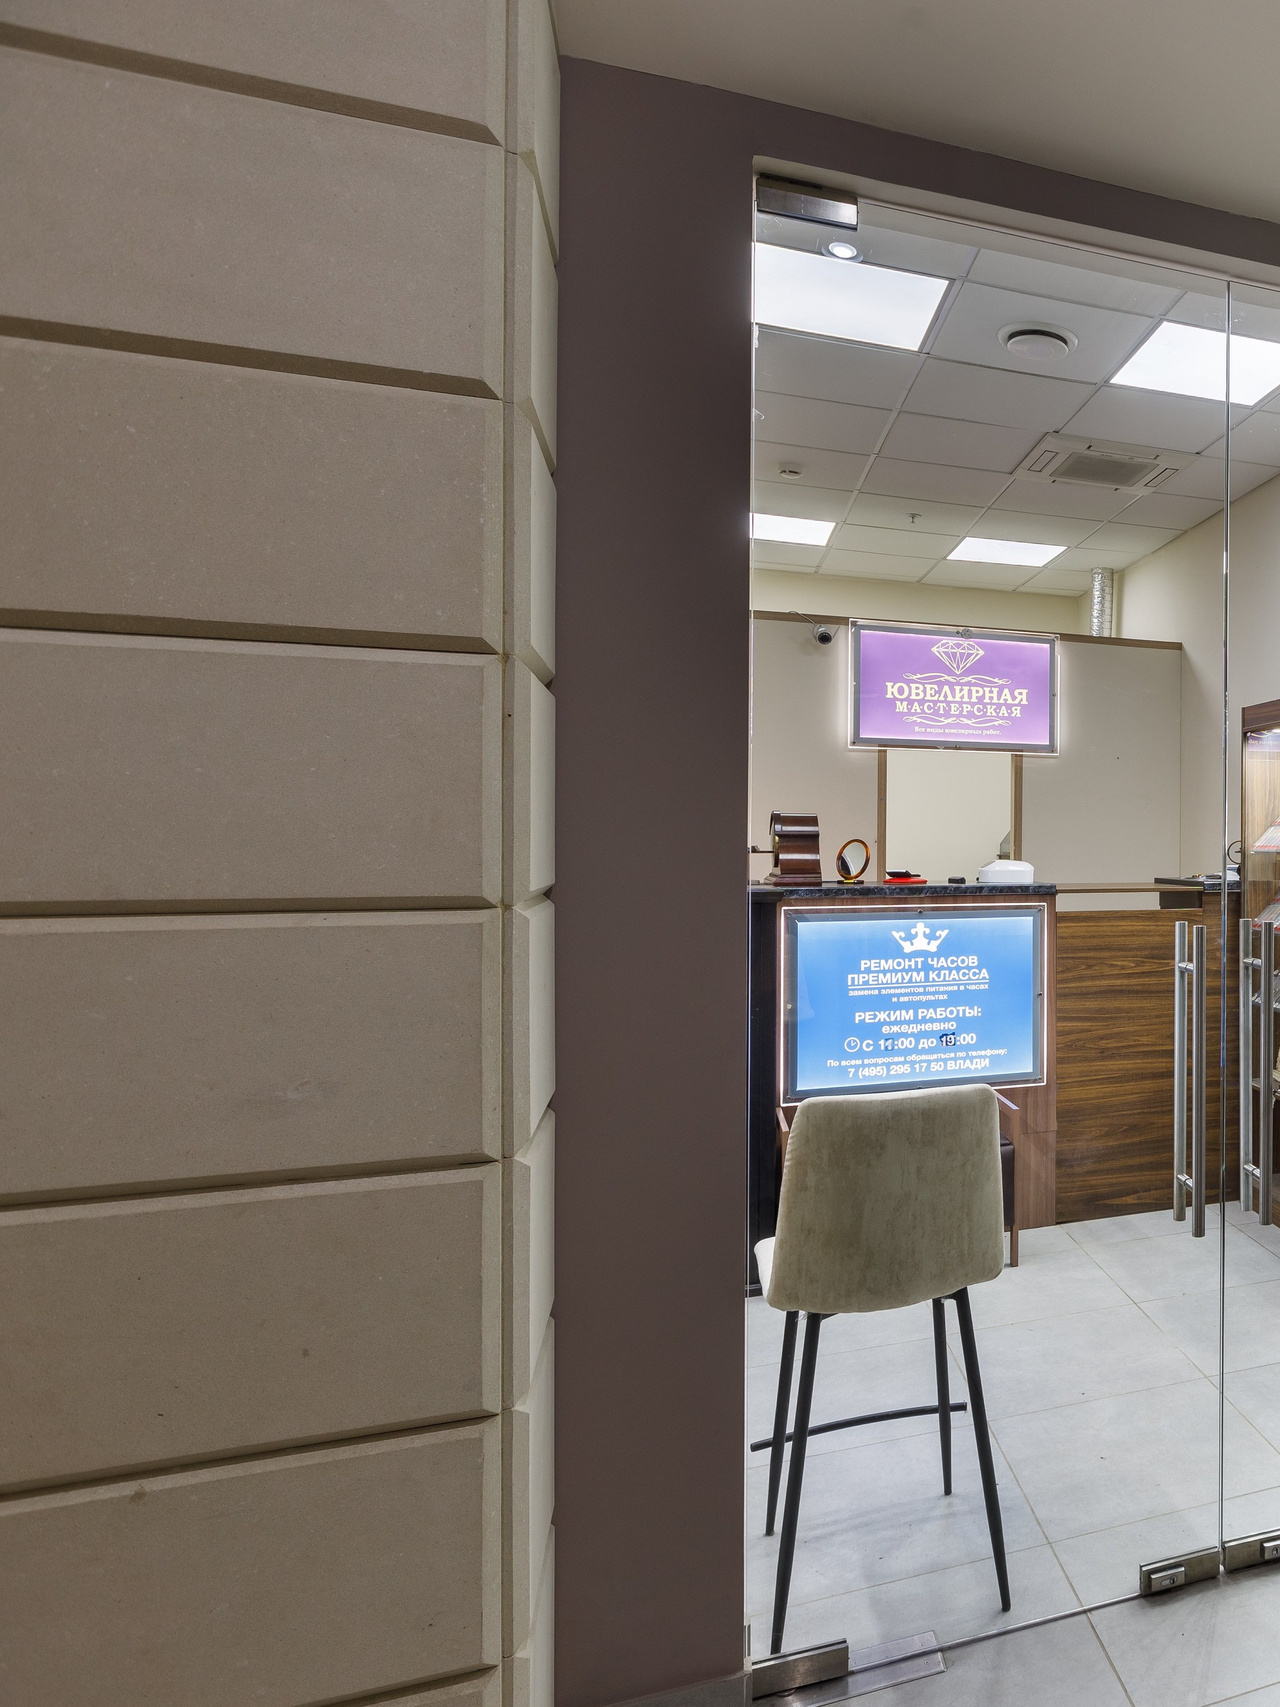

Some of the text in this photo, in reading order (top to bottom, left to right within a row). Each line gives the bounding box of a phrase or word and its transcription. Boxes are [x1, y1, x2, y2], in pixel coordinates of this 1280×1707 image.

[886, 682, 1028, 705] ЮВЕЛИРНАЯ
[860, 955, 978, 971] РЕМОНТ ЧАСОВ
[847, 968, 989, 986] ПРЕМИУМ КЛАССА
[848, 988, 879, 996] замена
[881, 986, 924, 994] элементов
[926, 984, 958, 992] питания
[899, 994, 948, 1003] автопультах
[855, 1006, 982, 1024] РЕЖИМ РАБОТЫ:
[882, 1021, 957, 1034] ежедневно
[918, 1038, 937, 1050] до
[939, 1033, 976, 1047] 19:00
[827, 1059, 839, 1067] По
[841, 1058, 862, 1066] всем
[864, 1056, 904, 1065] вопросам
[906, 1052, 954, 1062] обращаться
[848, 1058, 990, 1079] 7 (495) 295 17 50 ВЛАДИ
